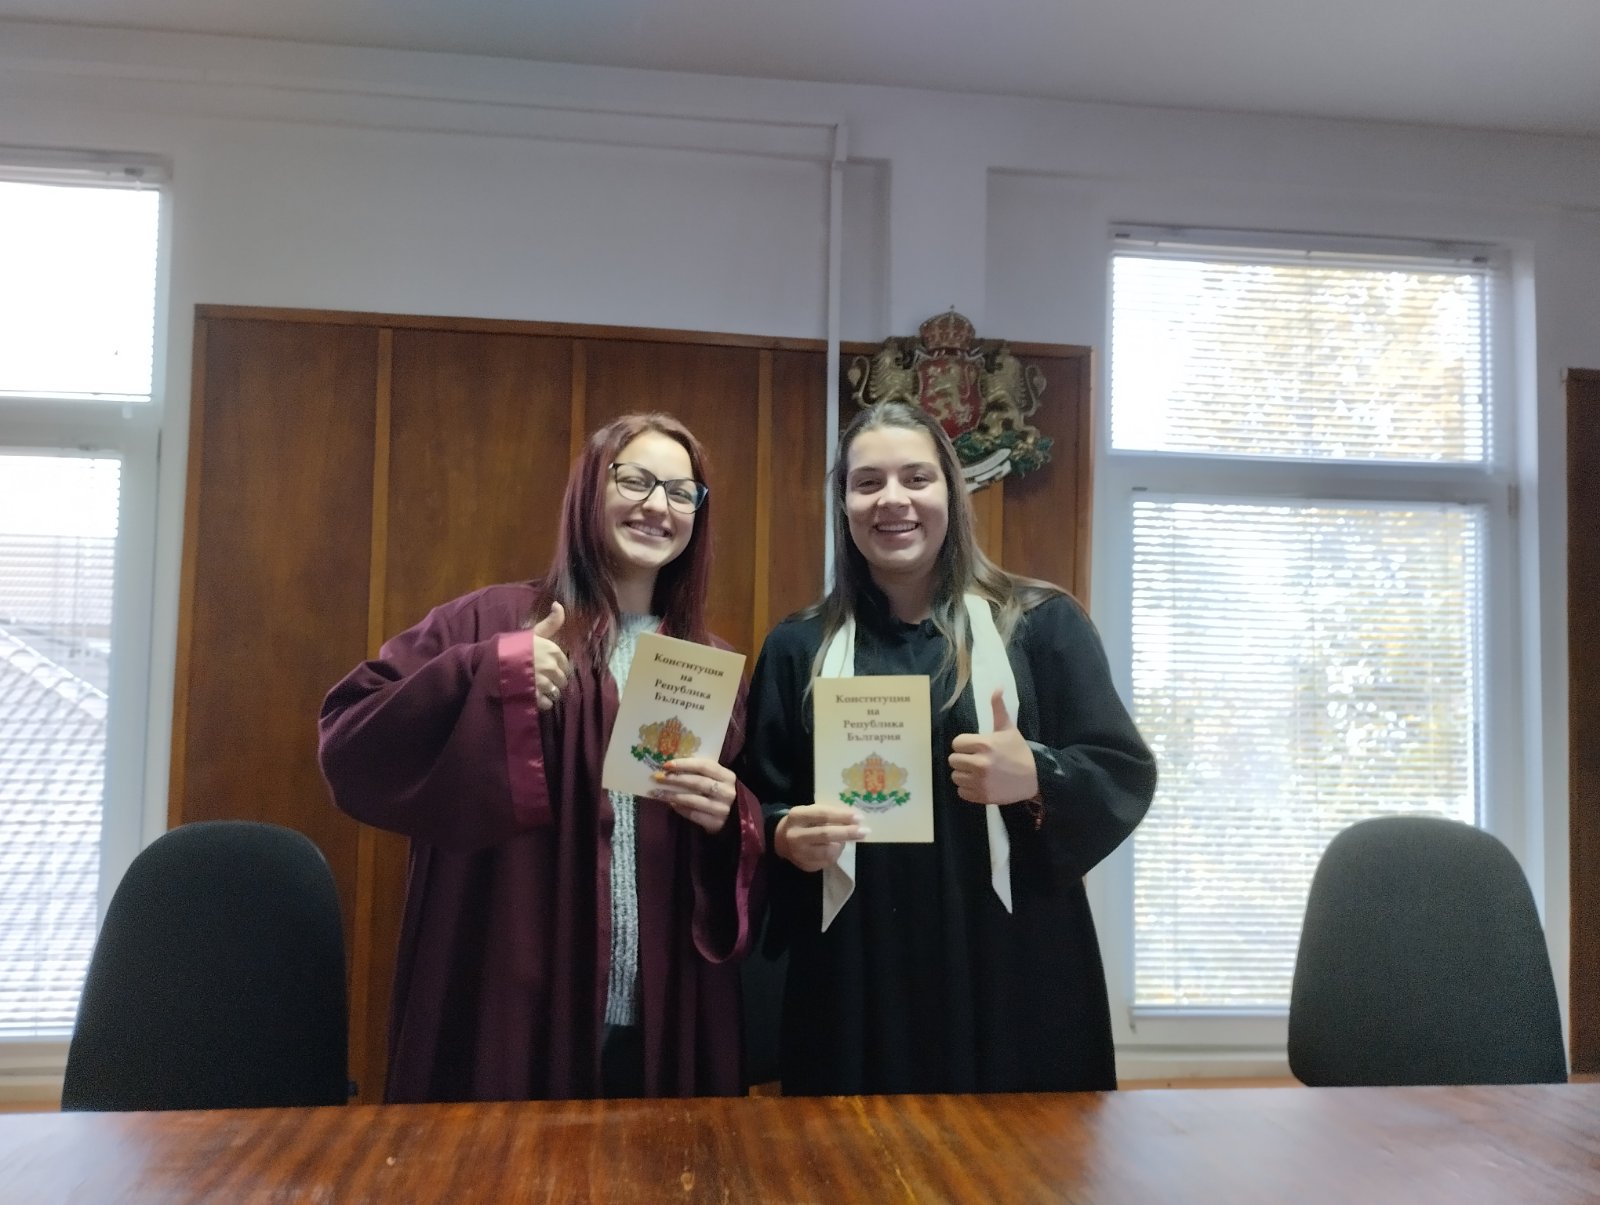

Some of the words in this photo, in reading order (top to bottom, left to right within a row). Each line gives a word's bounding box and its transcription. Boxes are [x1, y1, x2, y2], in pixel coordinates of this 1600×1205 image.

[654, 653, 724, 677] Конституция
[680, 674, 693, 682] на
[654, 679, 711, 699] Република
[654, 692, 705, 711] България
[835, 694, 911, 706] Конституция
[867, 708, 880, 716] на
[843, 720, 904, 731] Република
[847, 732, 901, 744] България
